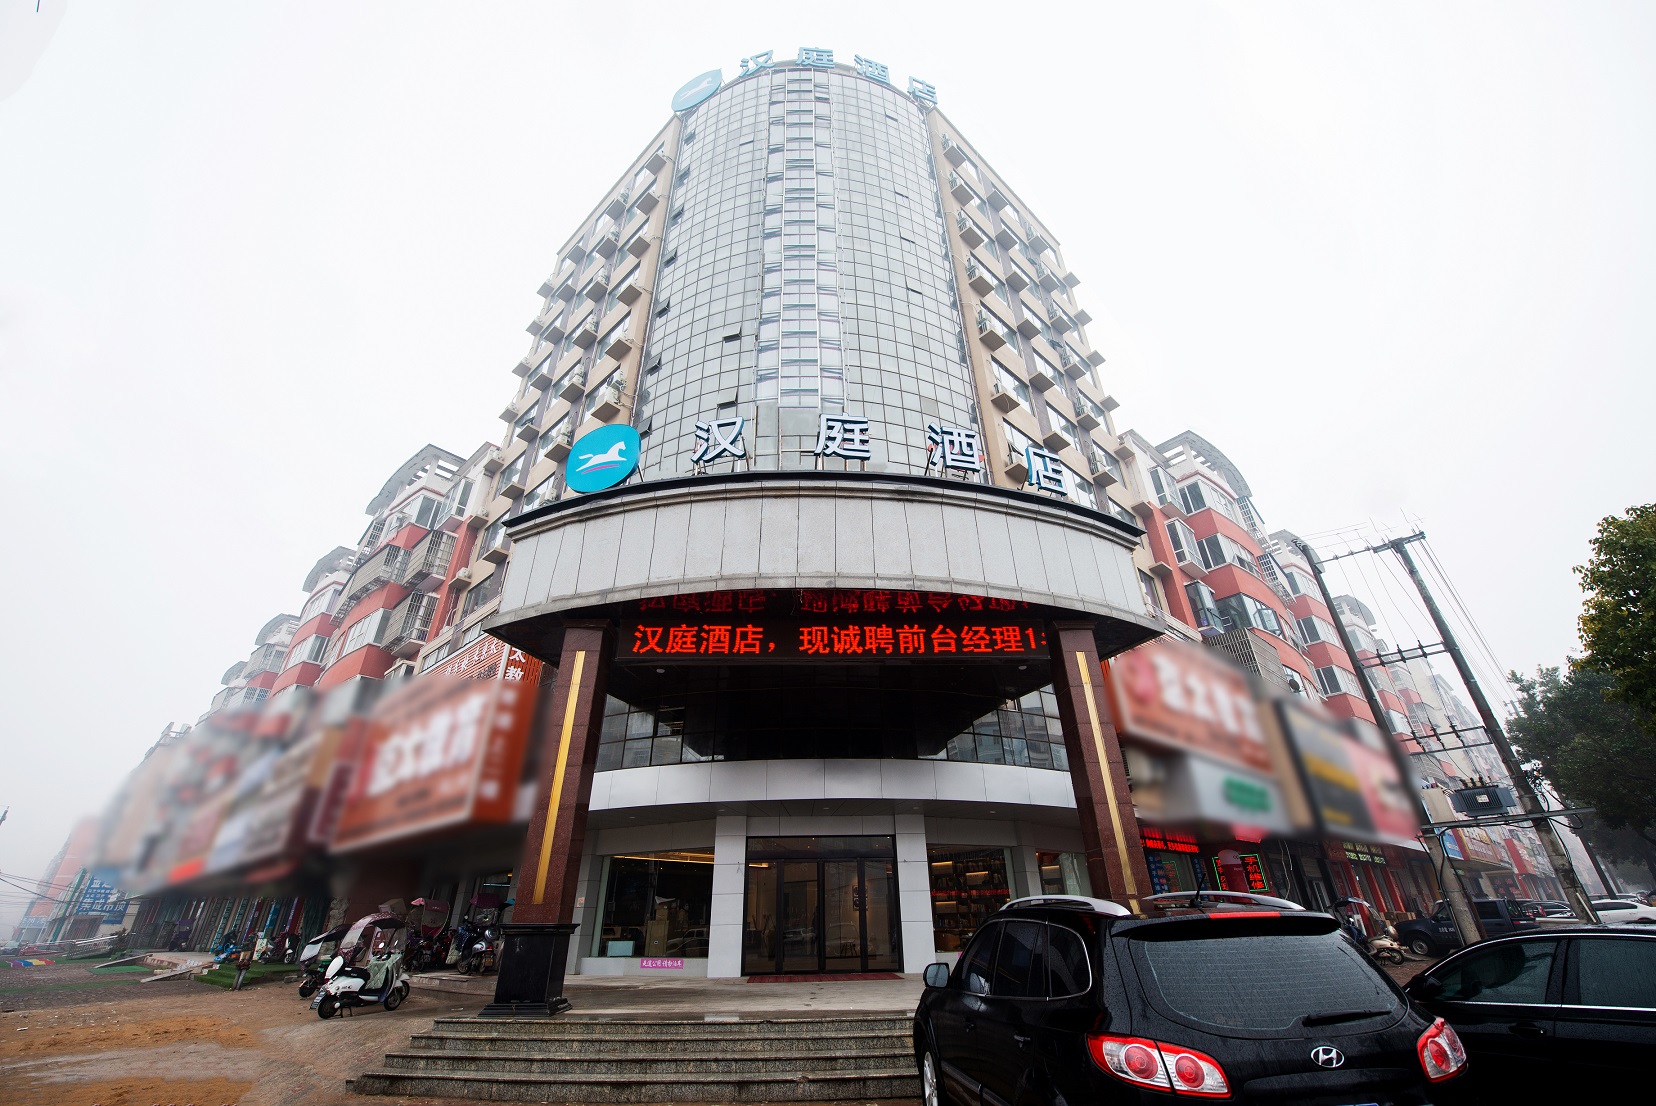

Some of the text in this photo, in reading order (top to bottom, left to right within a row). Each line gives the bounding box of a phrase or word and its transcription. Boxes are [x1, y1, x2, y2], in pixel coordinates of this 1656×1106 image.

[738, 46, 939, 105] 汉庭酒店
[691, 412, 1068, 496] 汉庭酒店
[633, 624, 1046, 655] 汉庭酒店，现诚聘前台经理1
[1244, 856, 1265, 889] 手机维修
